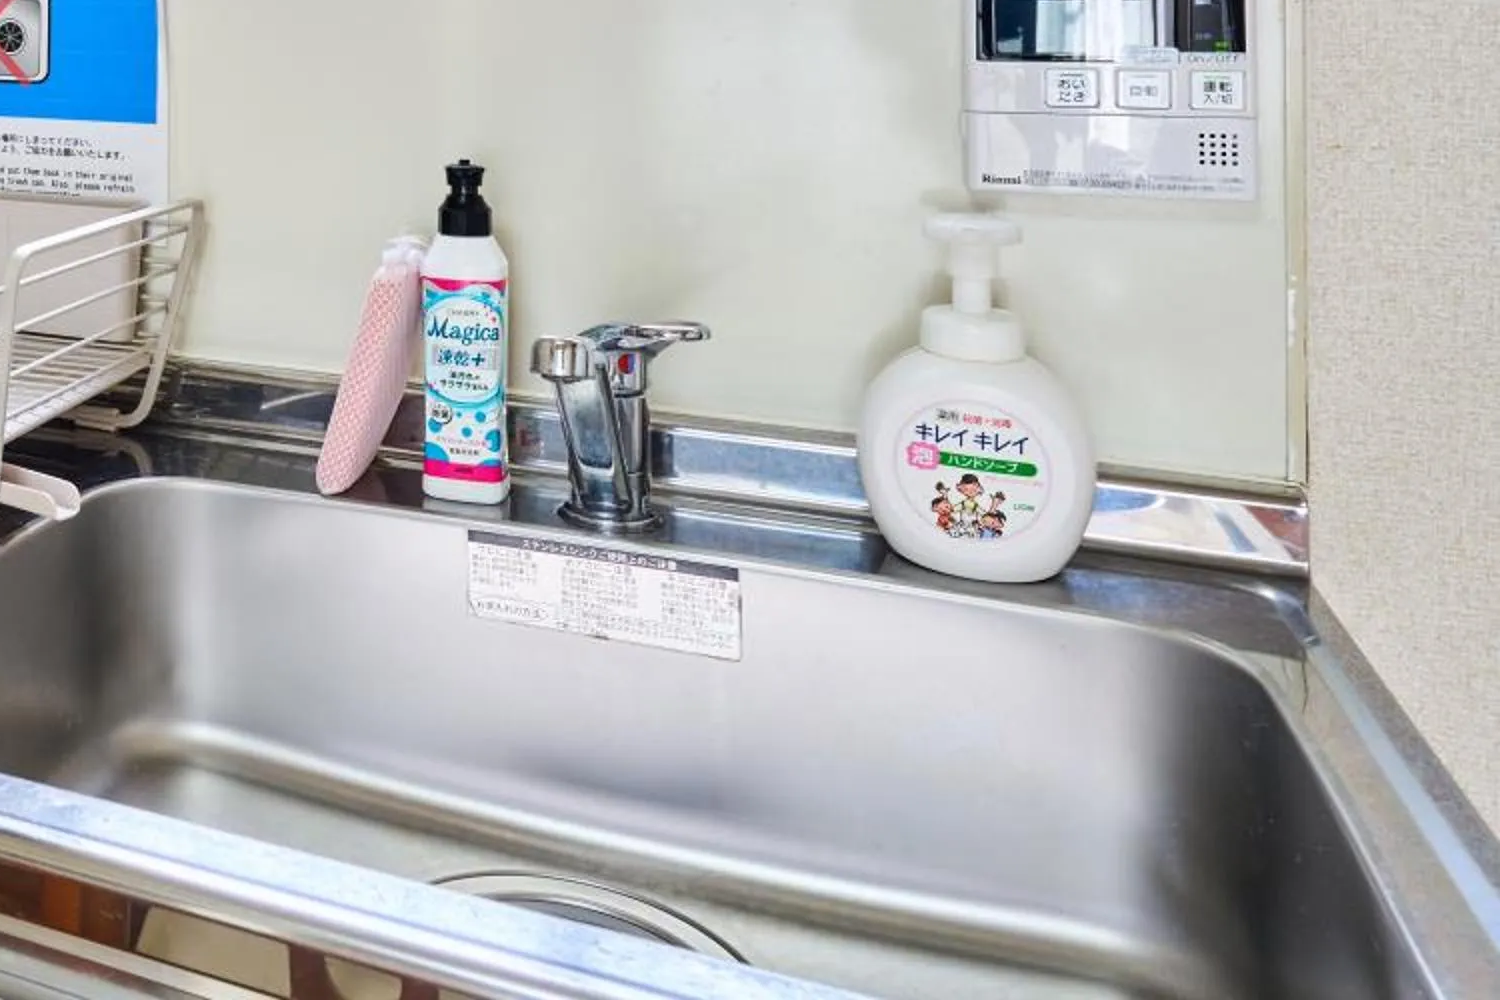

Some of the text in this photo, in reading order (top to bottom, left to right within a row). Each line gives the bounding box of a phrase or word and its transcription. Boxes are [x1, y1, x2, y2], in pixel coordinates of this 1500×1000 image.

[427, 316, 499, 346] Magica
[915, 424, 1029, 454] キレイキレイ
[947, 454, 1019, 473] ハンドソープ
